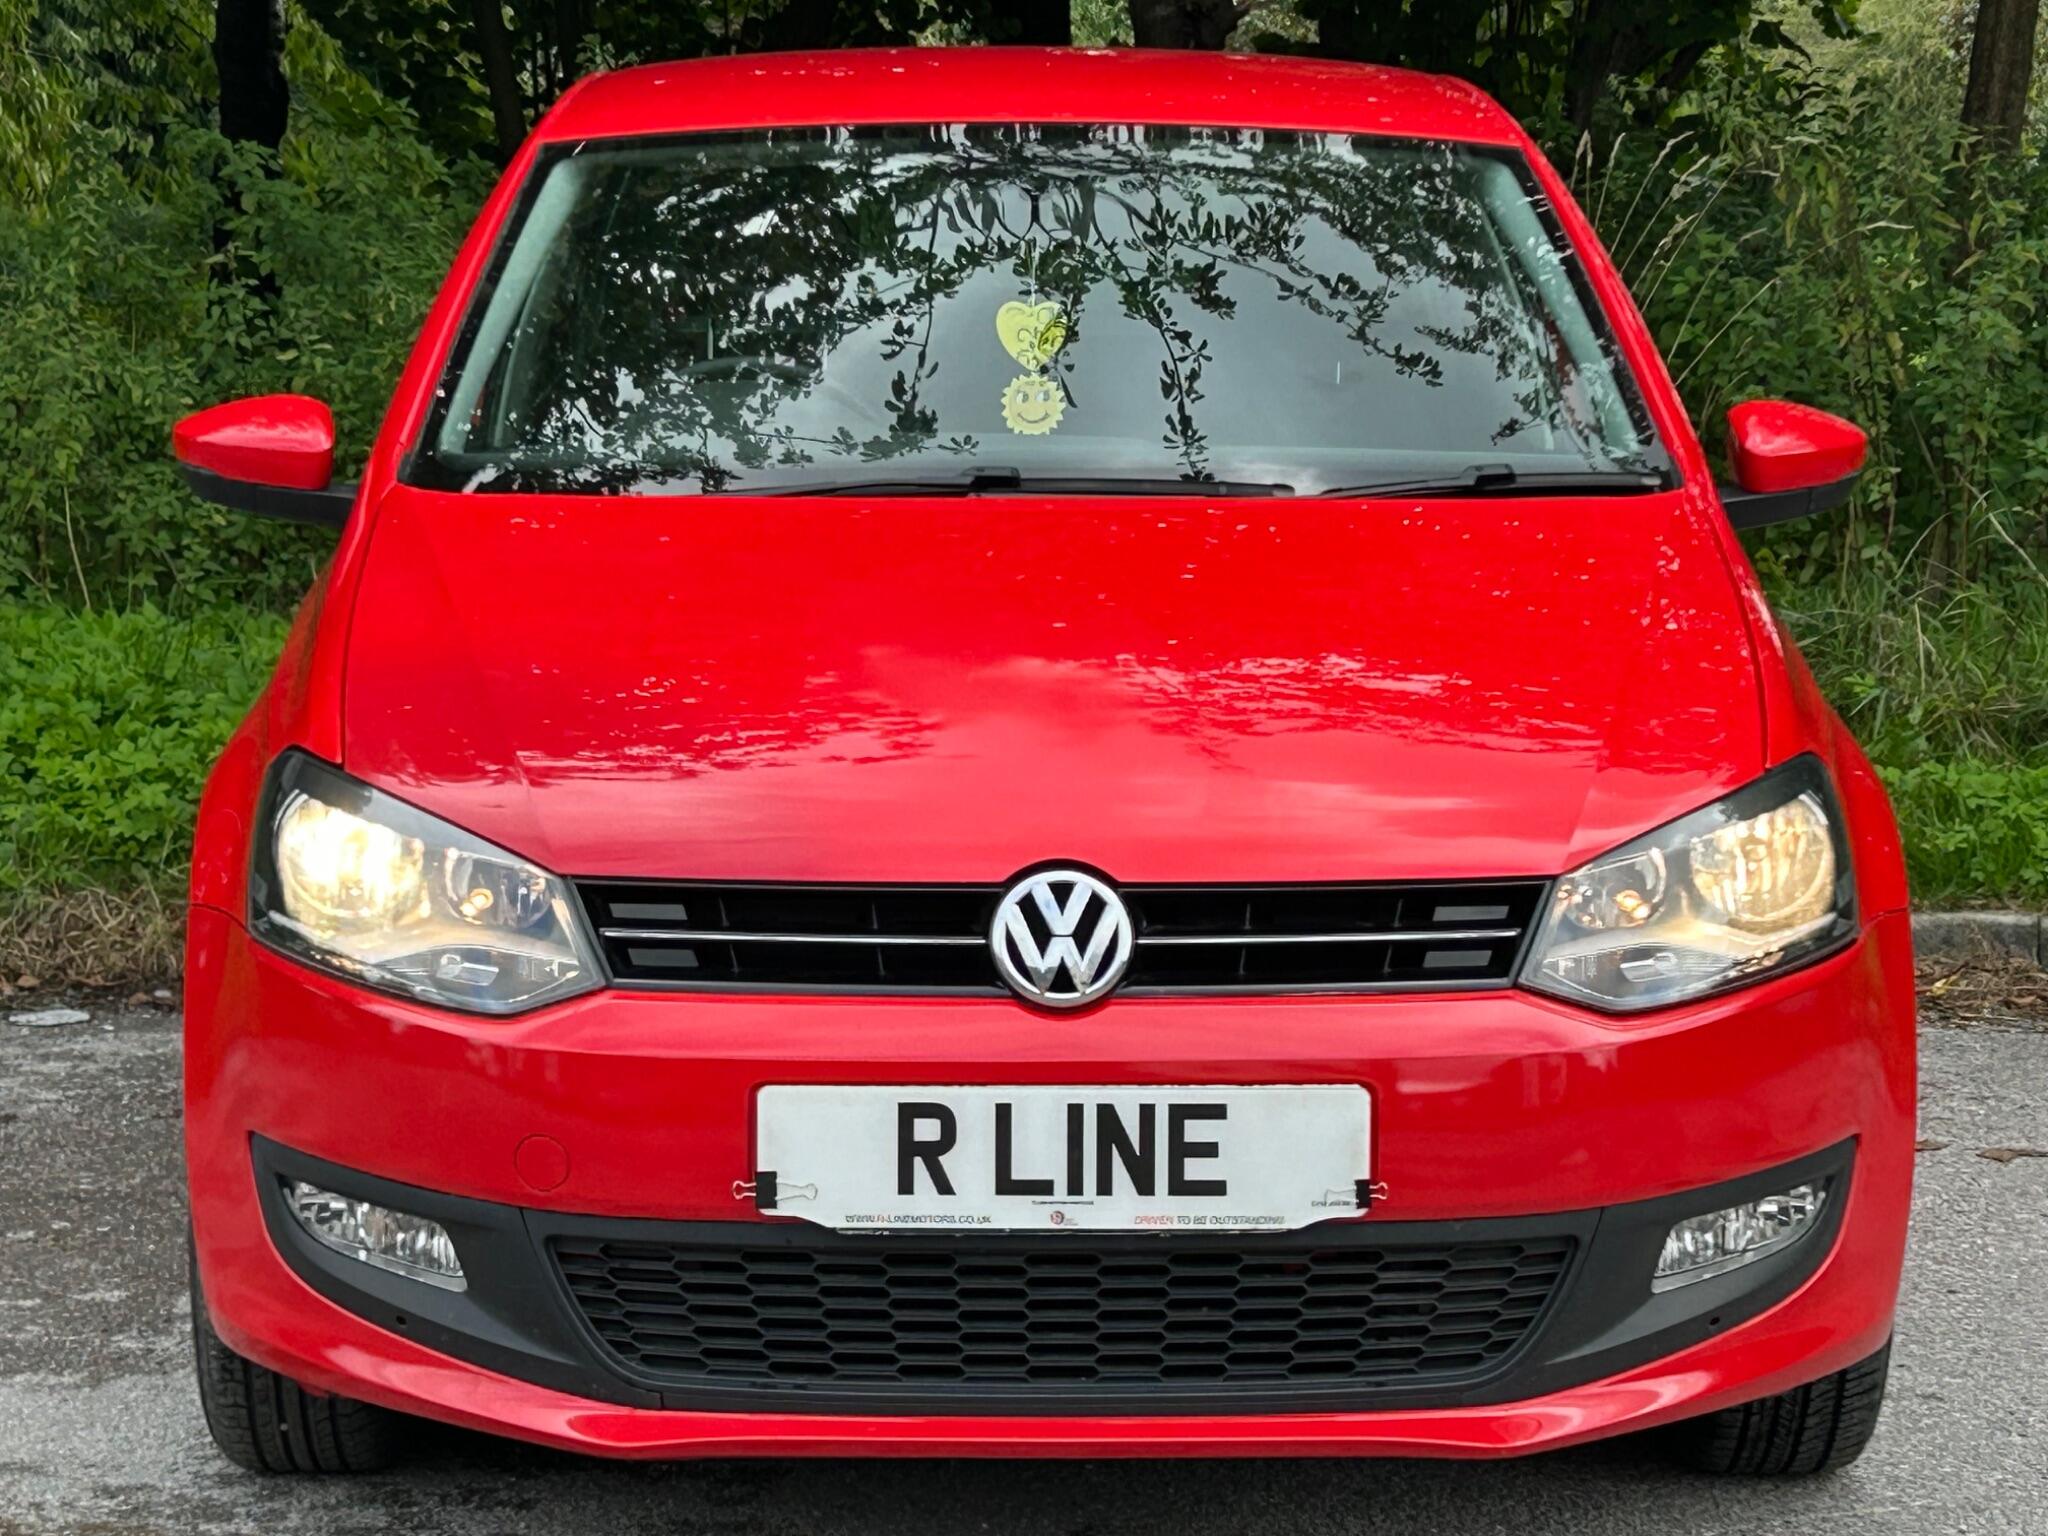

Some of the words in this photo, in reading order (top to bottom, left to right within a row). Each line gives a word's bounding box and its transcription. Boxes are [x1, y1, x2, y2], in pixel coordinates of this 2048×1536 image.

[1000, 875, 1124, 999] VW
[897, 1102, 957, 1196] R
[995, 1102, 1228, 1196] LINE
